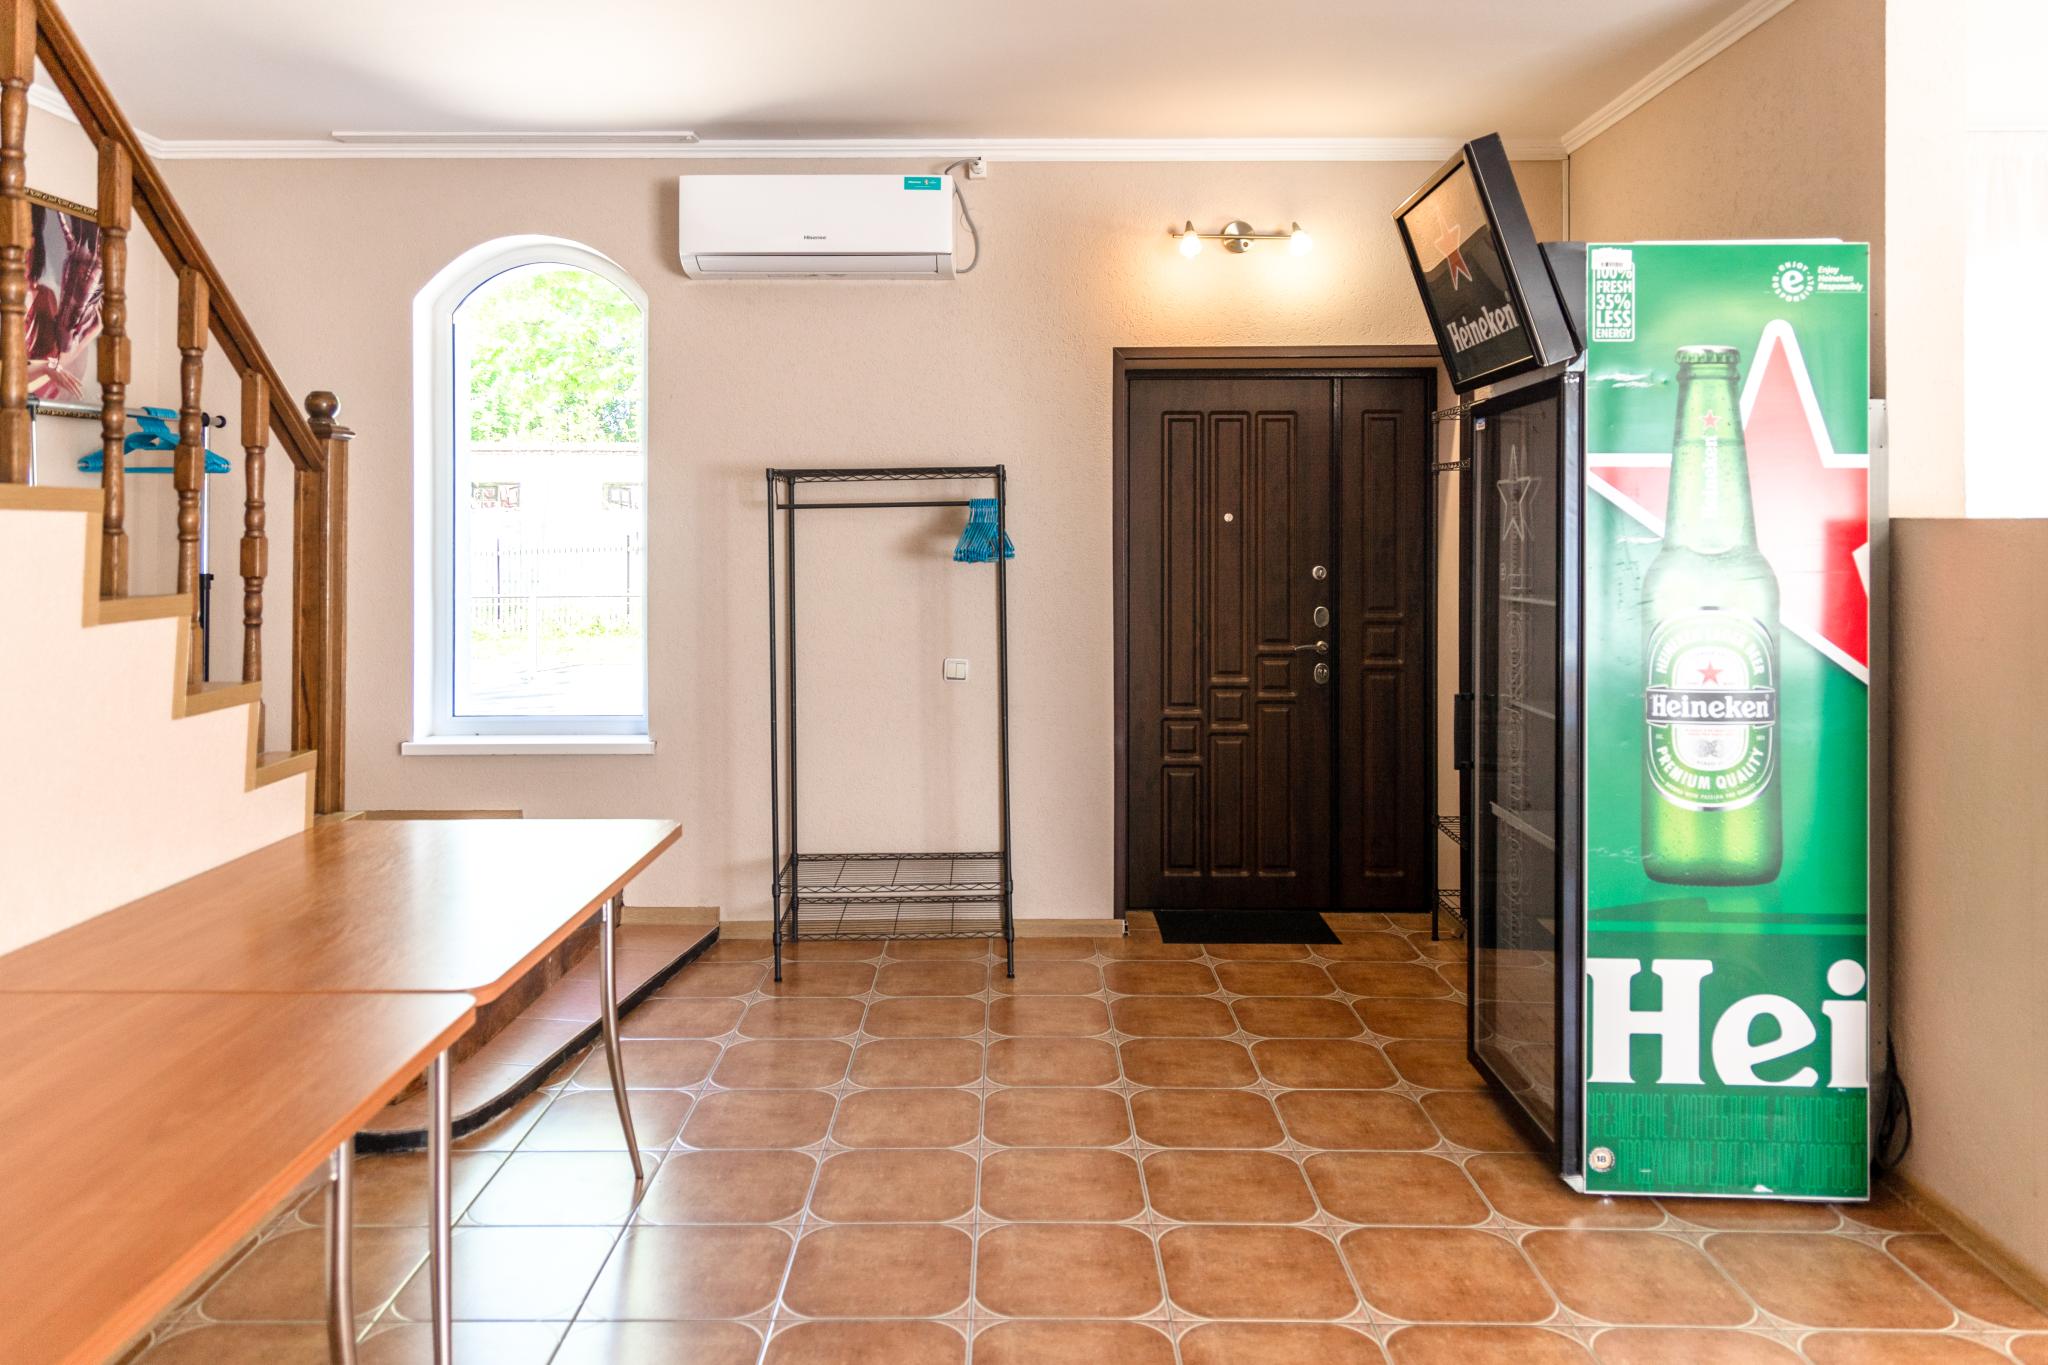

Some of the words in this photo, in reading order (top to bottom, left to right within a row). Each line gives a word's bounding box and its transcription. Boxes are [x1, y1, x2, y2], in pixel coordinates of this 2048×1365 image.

[1596, 280, 1632, 293] FRESH
[1596, 293, 1631, 310] 35%
[1596, 310, 1631, 327] LESS
[1447, 303, 1519, 353] Heineken
[1596, 328, 1631, 338] ENERGY
[1652, 694, 1769, 719] Heineken
[1656, 746, 1710, 790] PREMIUM
[1715, 747, 1764, 789] QUALITY
[1587, 958, 1868, 1088] Hei
[1597, 1155, 1607, 1163] 18
